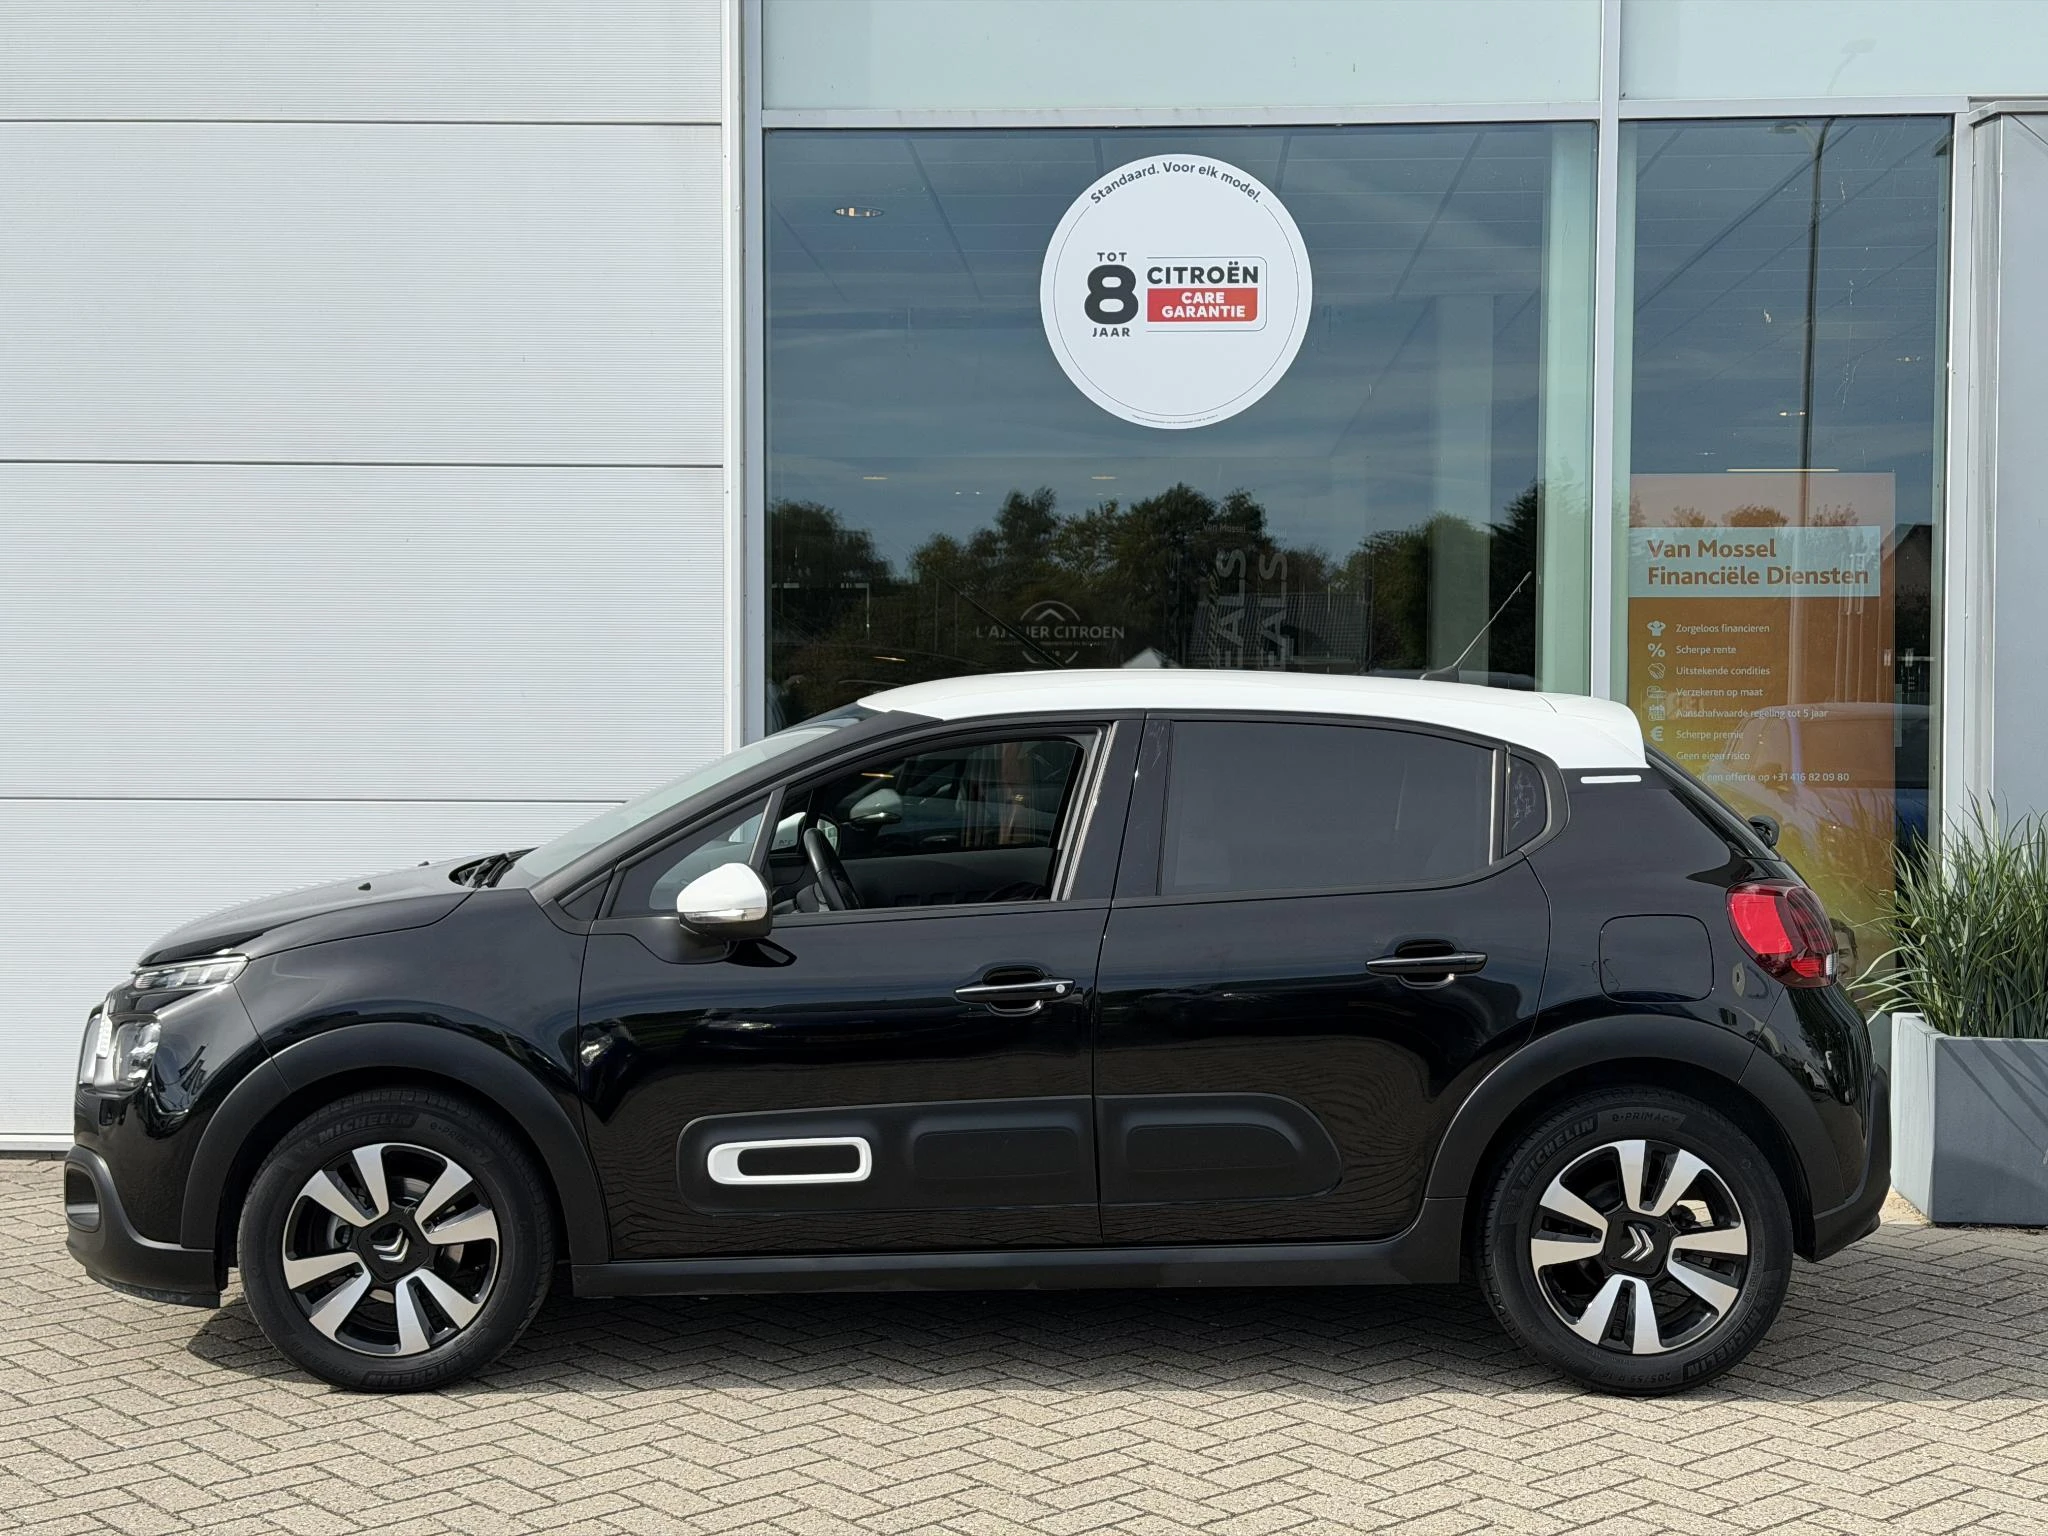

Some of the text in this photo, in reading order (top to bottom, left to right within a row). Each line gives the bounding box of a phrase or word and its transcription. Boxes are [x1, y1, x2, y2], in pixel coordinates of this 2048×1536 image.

[1090, 161, 1260, 204] Standaard. Voor elk model.
[1097, 252, 1127, 262] TOT
[1147, 261, 1258, 284] CITROËN
[1084, 264, 1139, 324] 8
[1181, 292, 1225, 304] CARE
[1161, 306, 1246, 318] GARANTIE
[1092, 327, 1131, 338] JAAR
[1647, 538, 1777, 558] Van Mossel
[1648, 565, 1869, 585] Financiële Diensten
[1676, 622, 1770, 635] Zorgeloos financieren
[1676, 644, 1737, 656] Scherpe rente
[1676, 665, 1770, 676] Uitstekende condities
[1676, 687, 1763, 699] Verzekeren op maat
[1676, 708, 1828, 720] Aanschafwaarde regeling tot 5 jaar
[1676, 729, 1744, 741] Scherpe premie
[1676, 751, 1699, 760] Geen
[1728, 750, 1750, 760] risico
[1725, 772, 1756, 782] offerte
[1758, 774, 1769, 784] op
[1771, 773, 1788, 782] +31
[1808, 772, 1820, 782] 82
[1823, 772, 1835, 782] 09
[1837, 772, 1849, 782] 80
[1520, 1118, 1594, 1185] MICHELIN
